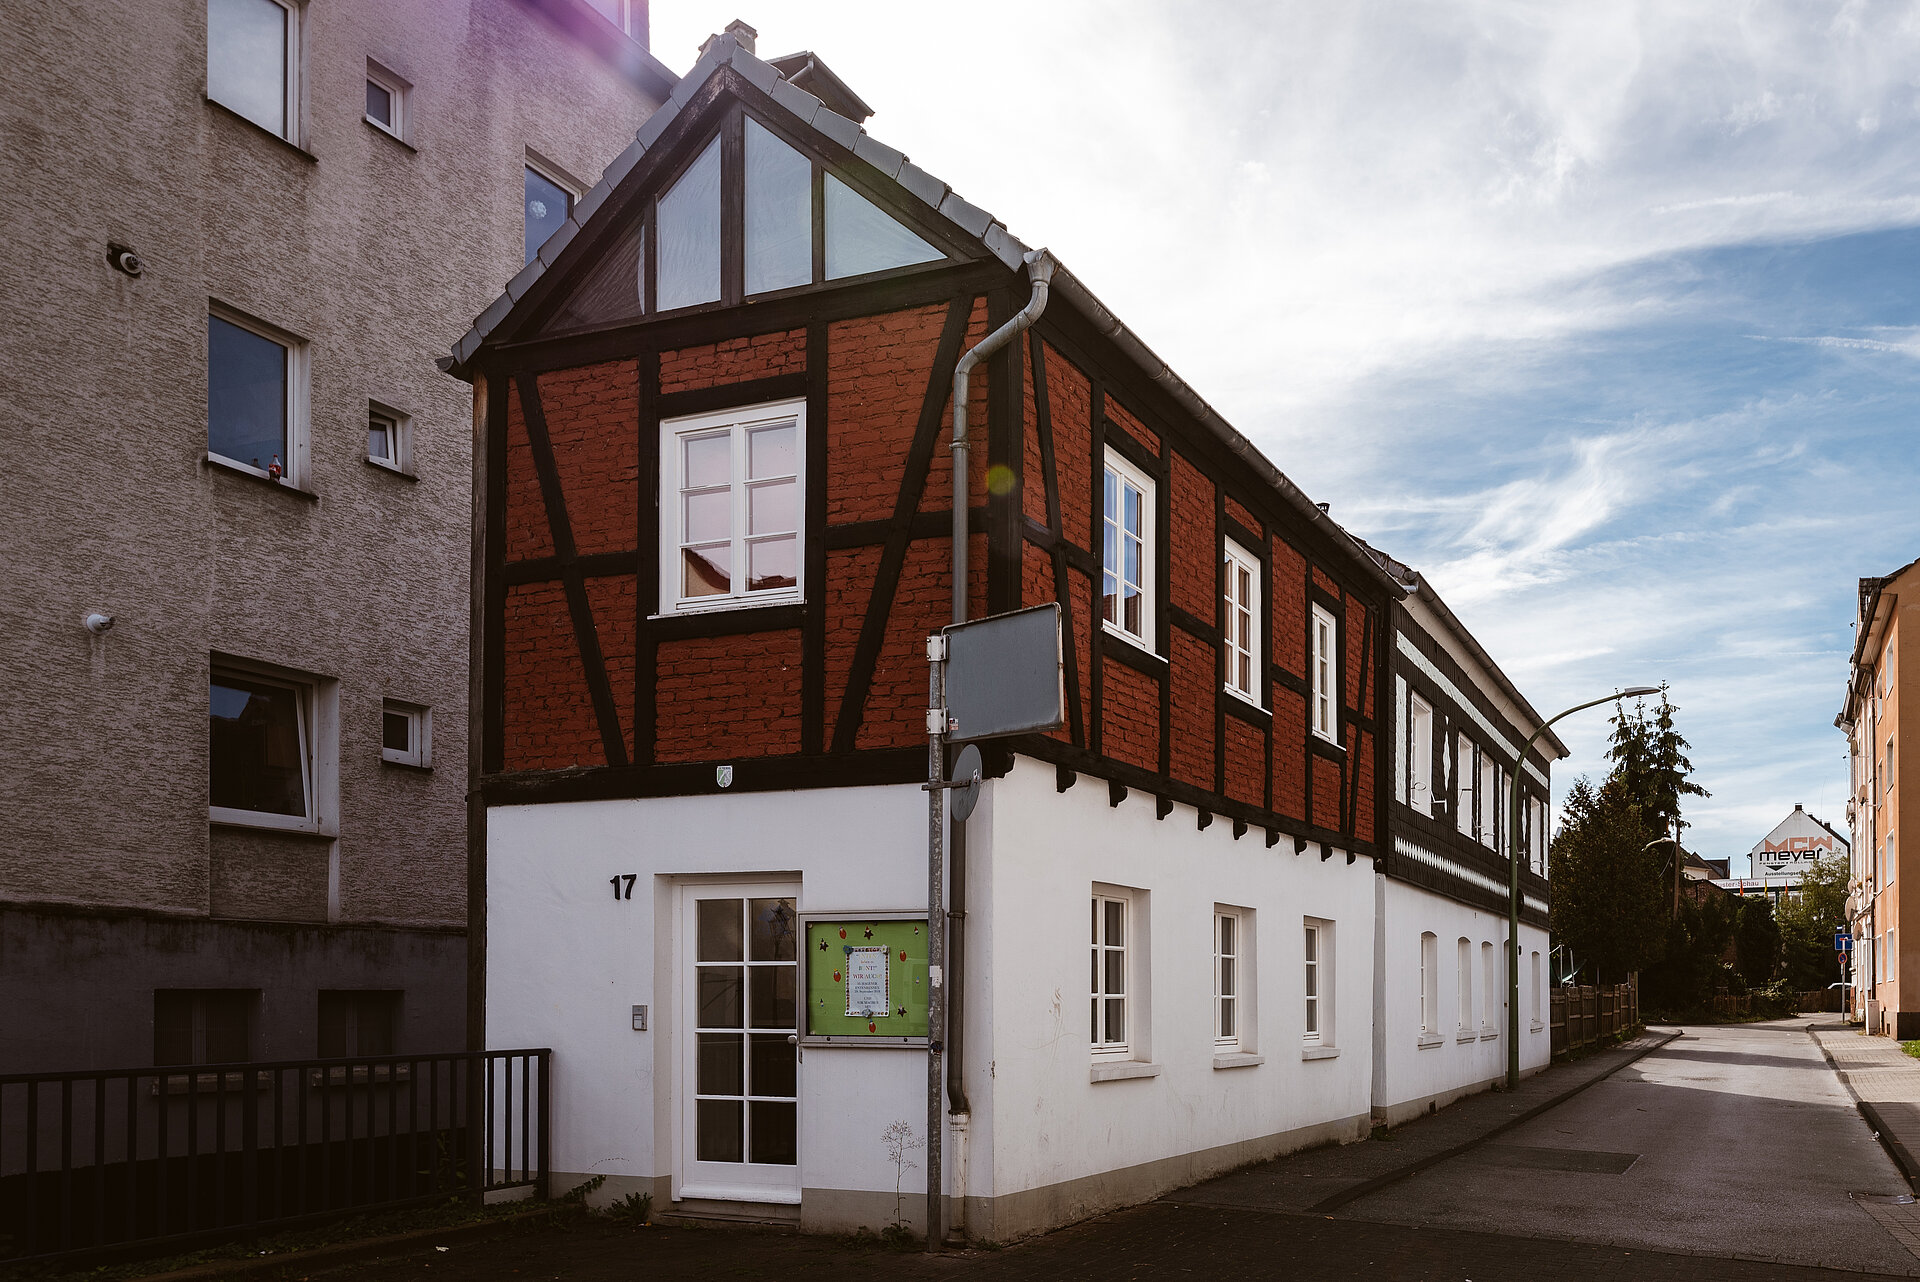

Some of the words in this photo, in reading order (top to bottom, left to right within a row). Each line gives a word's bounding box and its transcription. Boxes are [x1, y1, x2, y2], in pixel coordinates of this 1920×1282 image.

[1765, 836, 1832, 853] MCW
[1760, 848, 1823, 861] meyer
[610, 874, 637, 900] 17
